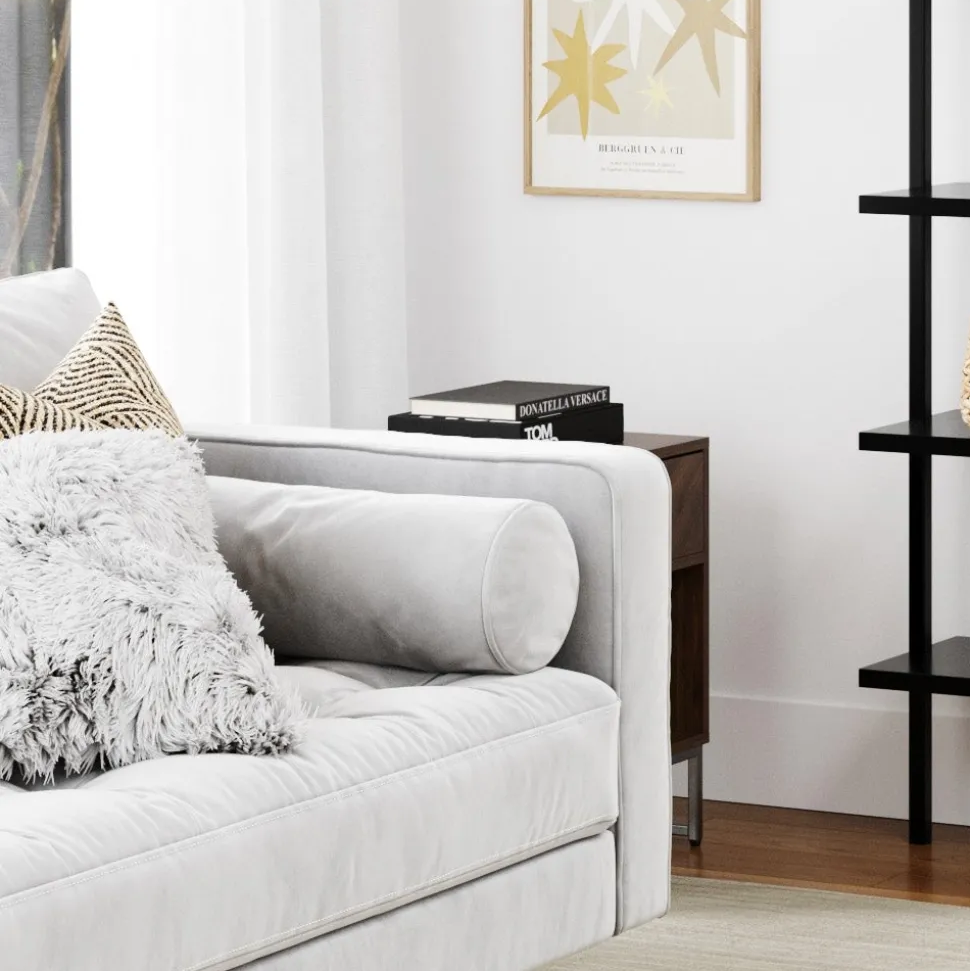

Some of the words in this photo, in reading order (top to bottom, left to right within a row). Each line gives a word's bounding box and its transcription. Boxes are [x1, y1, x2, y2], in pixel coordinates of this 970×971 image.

[519, 396, 570, 418] DONATELLA
[570, 389, 608, 407] VERSACE
[524, 422, 553, 441] TOM
